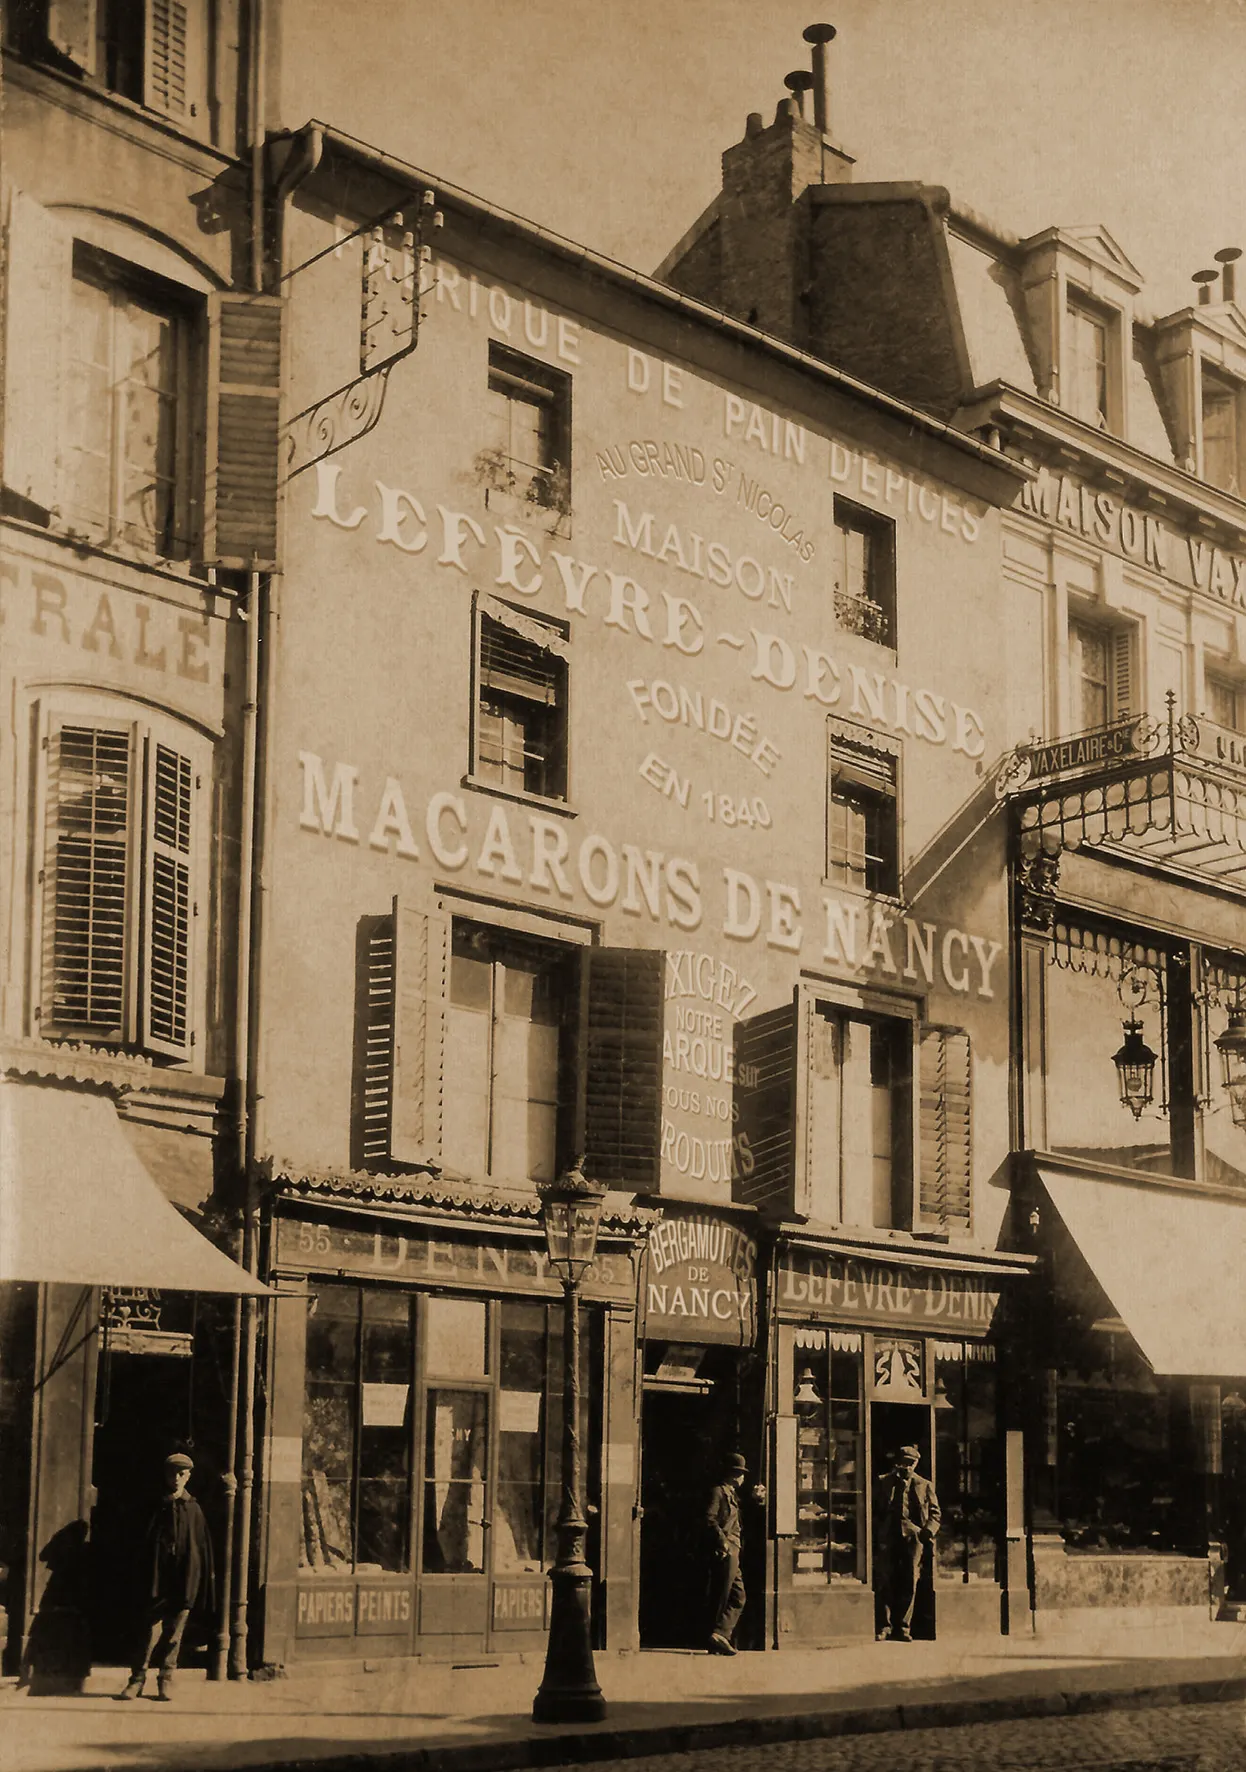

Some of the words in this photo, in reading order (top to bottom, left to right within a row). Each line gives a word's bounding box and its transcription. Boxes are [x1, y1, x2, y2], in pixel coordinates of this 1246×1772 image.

[334, 214, 583, 367] FABRIQUE
[627, 349, 685, 408] DE
[724, 394, 806, 464] PAIN
[596, 445, 627, 481] AU
[629, 440, 706, 486] GRAND
[737, 472, 815, 563] NICOLAS
[1018, 468, 1166, 573] MAISON
[612, 498, 796, 614] MAISON
[0, 560, 210, 684] RALE
[626, 679, 783, 779] FONDÉE
[1031, 735, 1108, 775] VAXELAIRE
[639, 752, 692, 810] EN
[702, 790, 773, 830] 1840
[299, 750, 702, 932] MACARONS
[723, 867, 803, 954] DE
[821, 898, 1003, 1001] NANCY
[664, 949, 757, 1028] XIGEZ
[676, 1006, 722, 1041] NOTRE
[663, 1030, 737, 1087] ARQUE
[662, 1085, 701, 1116] OUS
[706, 1096, 740, 1122] NOS
[661, 1114, 754, 1183] RODUITS
[299, 1222, 331, 1255] 55
[649, 1215, 758, 1282] BERGAMOTTES
[648, 1284, 751, 1320] NANCY
[688, 1266, 709, 1282] DE
[299, 1591, 353, 1625] PAPIERS
[358, 1588, 410, 1622] PEINTS
[494, 1587, 543, 1619] PAPIERS
